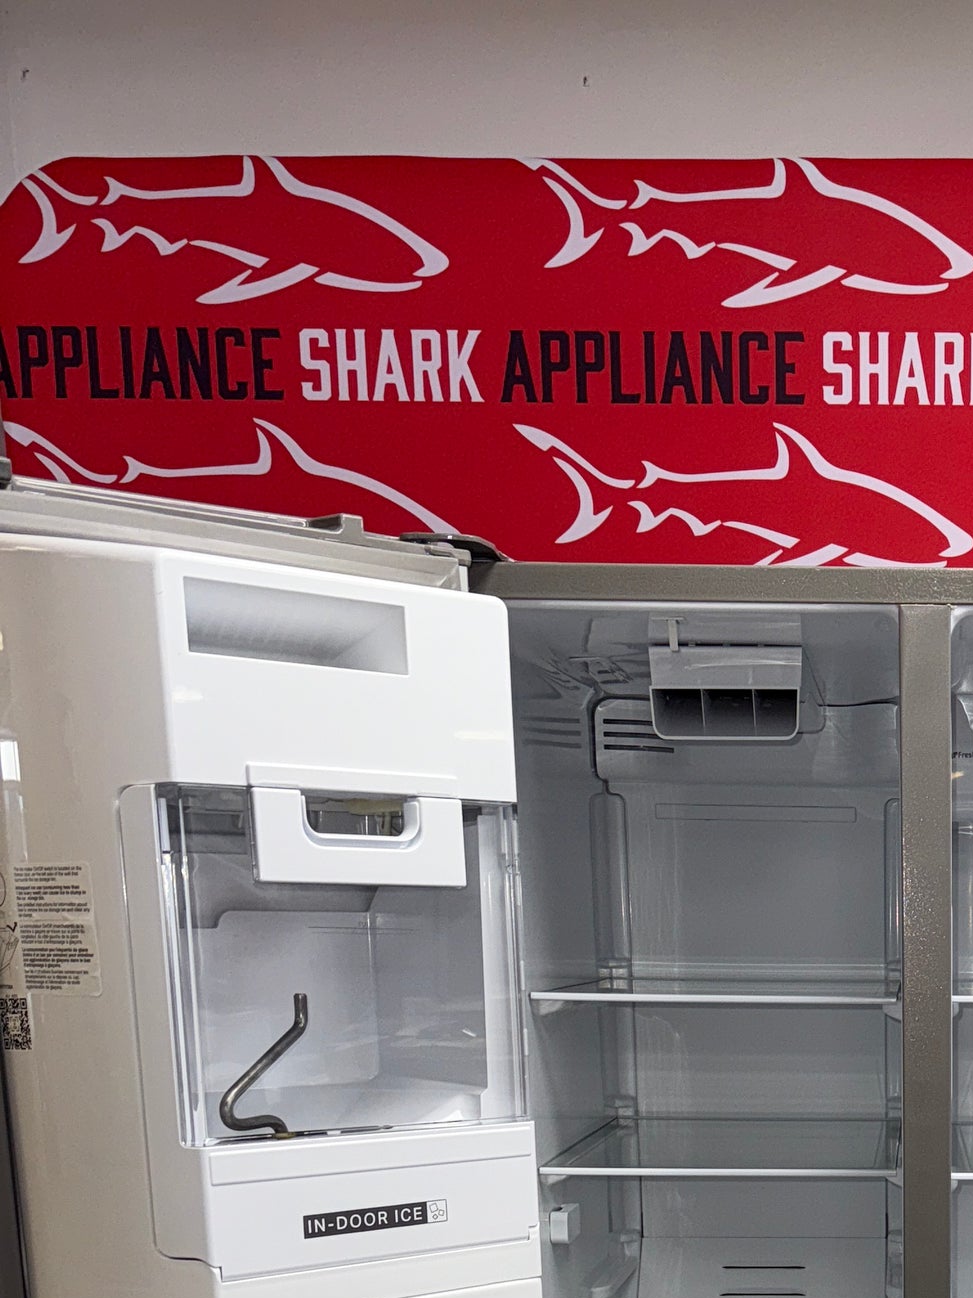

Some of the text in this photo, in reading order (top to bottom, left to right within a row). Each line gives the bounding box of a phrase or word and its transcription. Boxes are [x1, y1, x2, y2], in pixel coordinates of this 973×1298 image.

[299, 328, 483, 402] SHARK
[500, 329, 805, 405] APPLIANCE
[307, 1206, 423, 1234] IN-DOOR ICE
